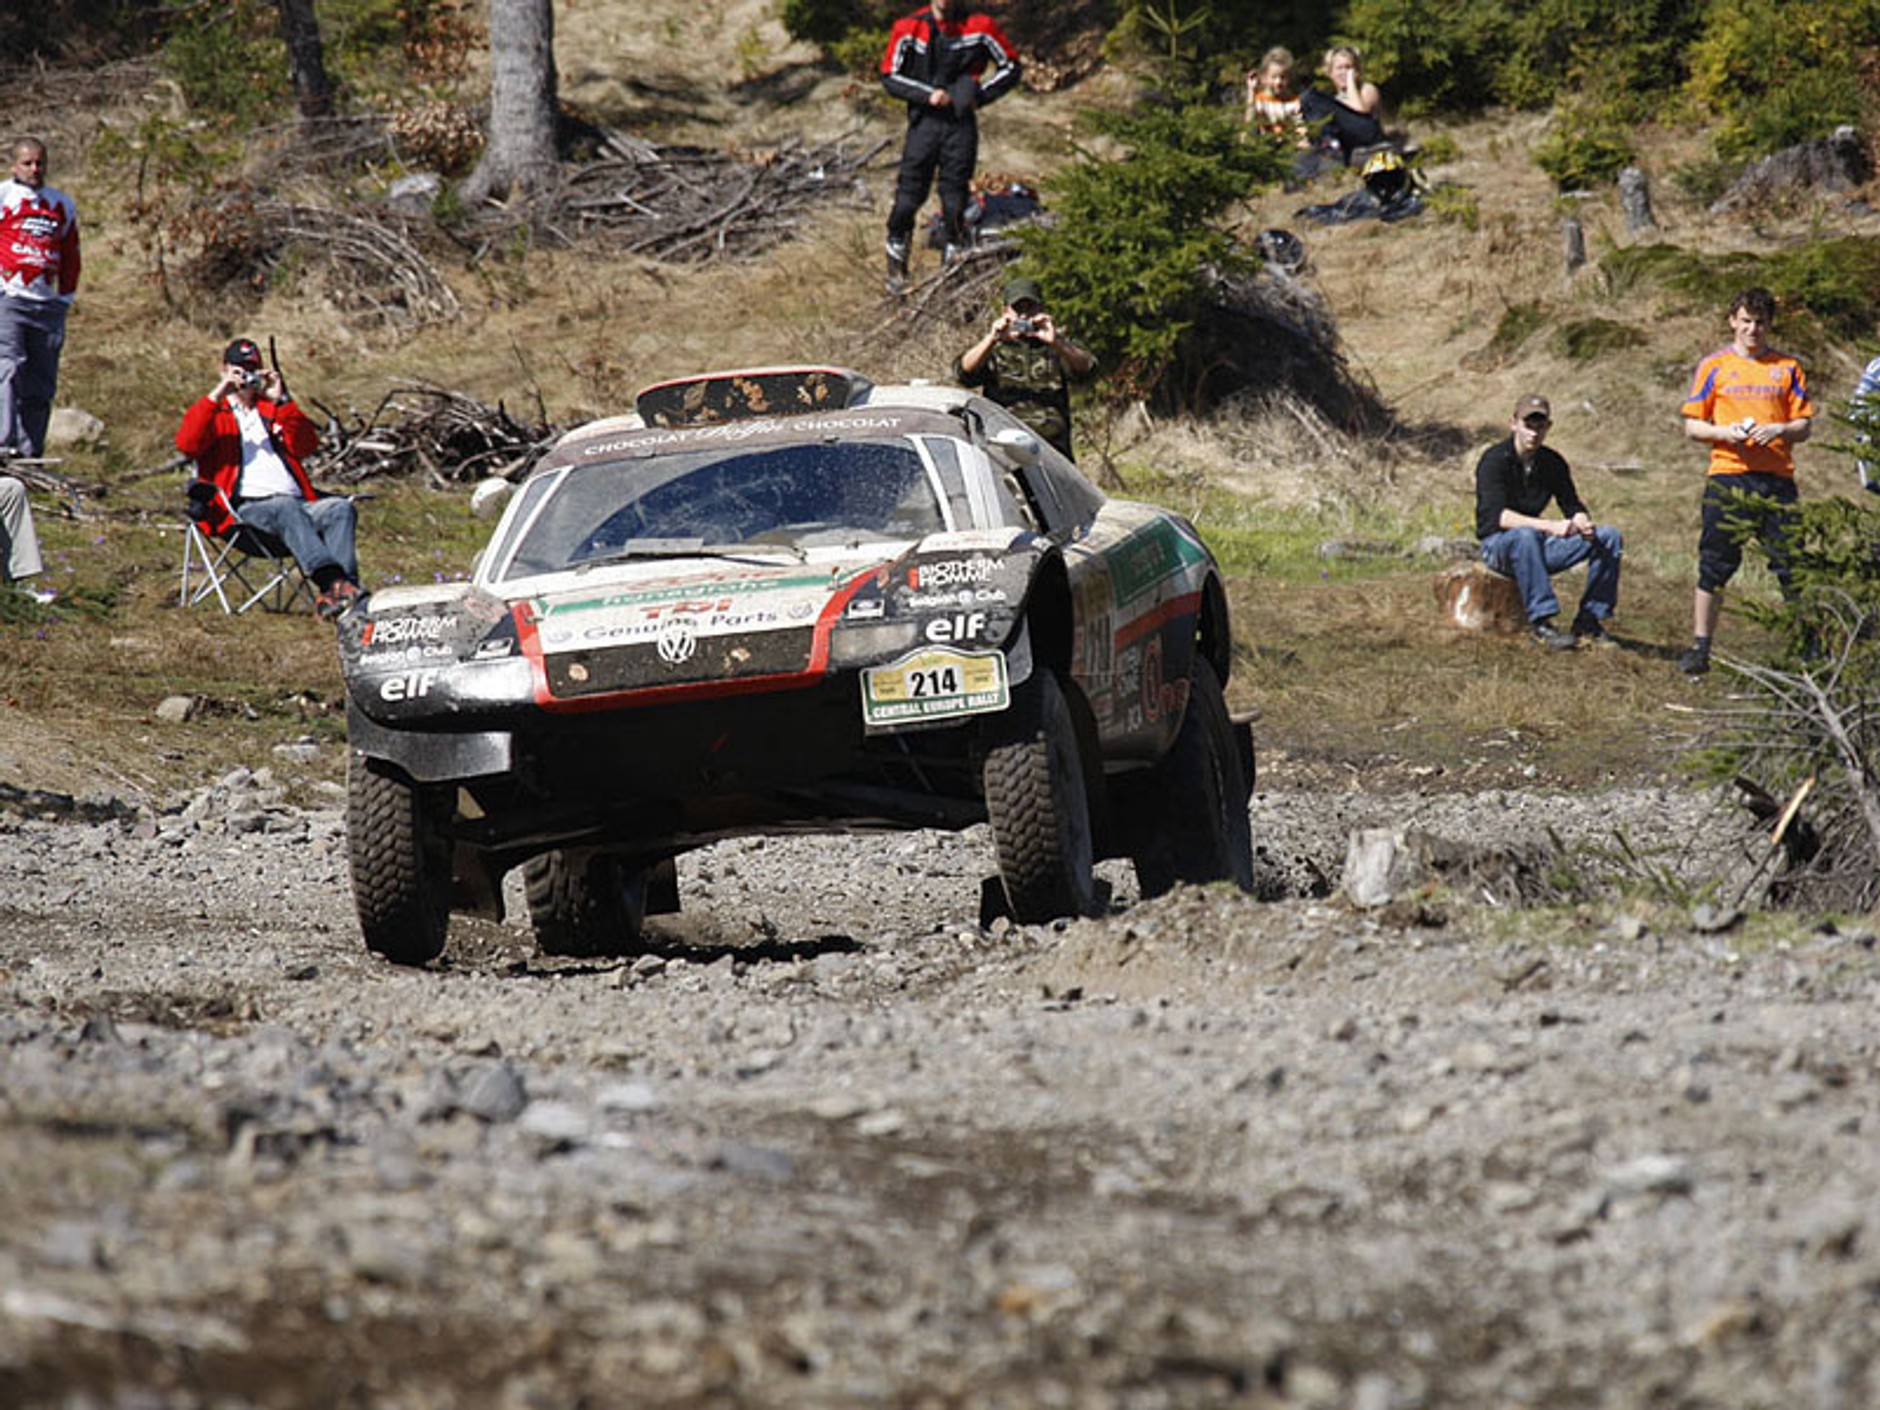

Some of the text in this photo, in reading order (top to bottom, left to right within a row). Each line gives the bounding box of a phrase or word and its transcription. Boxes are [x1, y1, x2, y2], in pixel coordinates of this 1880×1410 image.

[585, 434, 687, 455] CHOCOLAT
[794, 418, 902, 432] CHOCOLAT
[917, 558, 1005, 576] BIOTHERM
[918, 569, 992, 588] HOMME
[975, 588, 1007, 601] Club
[583, 611, 778, 639] Genuine Parts
[925, 613, 986, 642] elf
[423, 645, 453, 658] Club
[380, 669, 437, 702] elf
[911, 667, 958, 697] 214
[872, 692, 1000, 719] CENTRAL EUROPE RALLY
